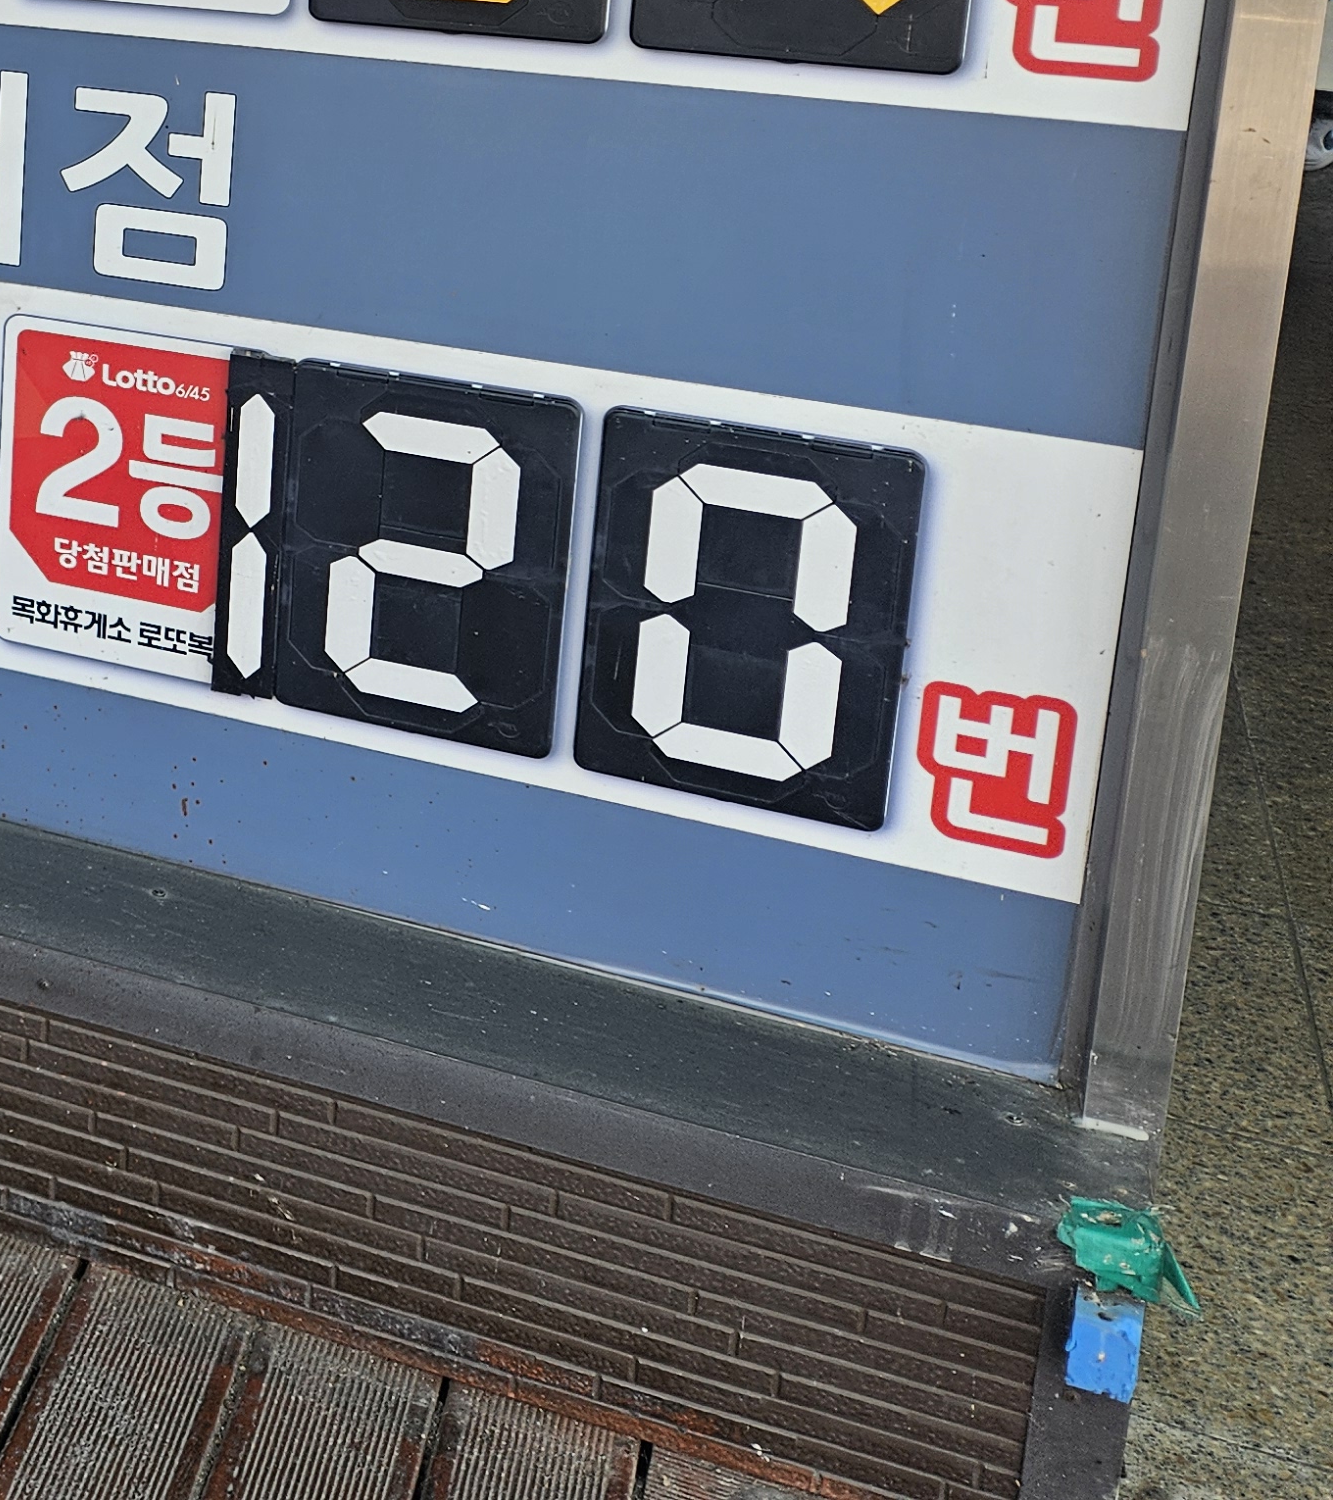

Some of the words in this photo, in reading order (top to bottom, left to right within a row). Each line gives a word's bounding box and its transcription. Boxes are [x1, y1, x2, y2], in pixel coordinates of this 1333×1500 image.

[35, 395, 223, 541] 2등
[54, 536, 200, 594] 당첨판매점
[12, 595, 132, 643] 목화휴게소
[918, 681, 1076, 859] 번
